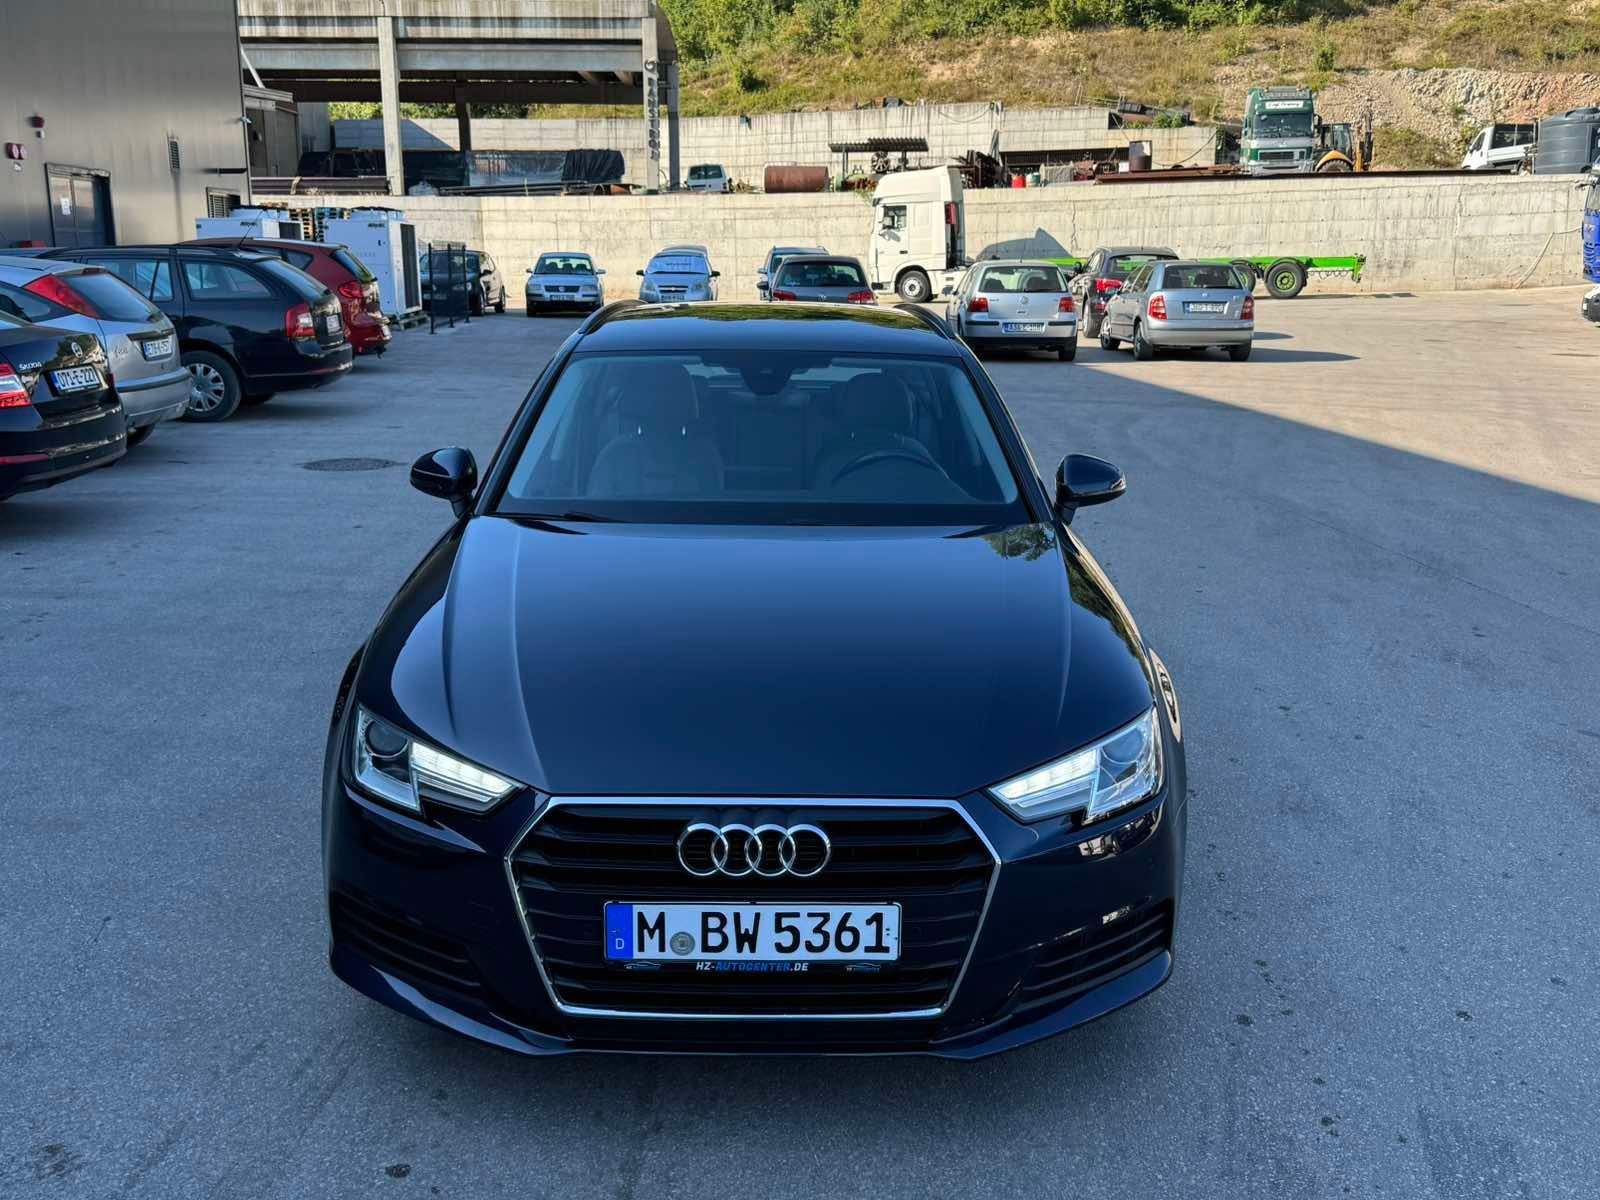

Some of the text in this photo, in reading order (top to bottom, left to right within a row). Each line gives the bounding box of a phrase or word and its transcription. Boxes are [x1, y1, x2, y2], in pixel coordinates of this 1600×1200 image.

[637, 911, 890, 953] M BW 5361
[615, 938, 625, 949] D
[696, 961, 809, 973] HZ-AUTOCENTER.DE
